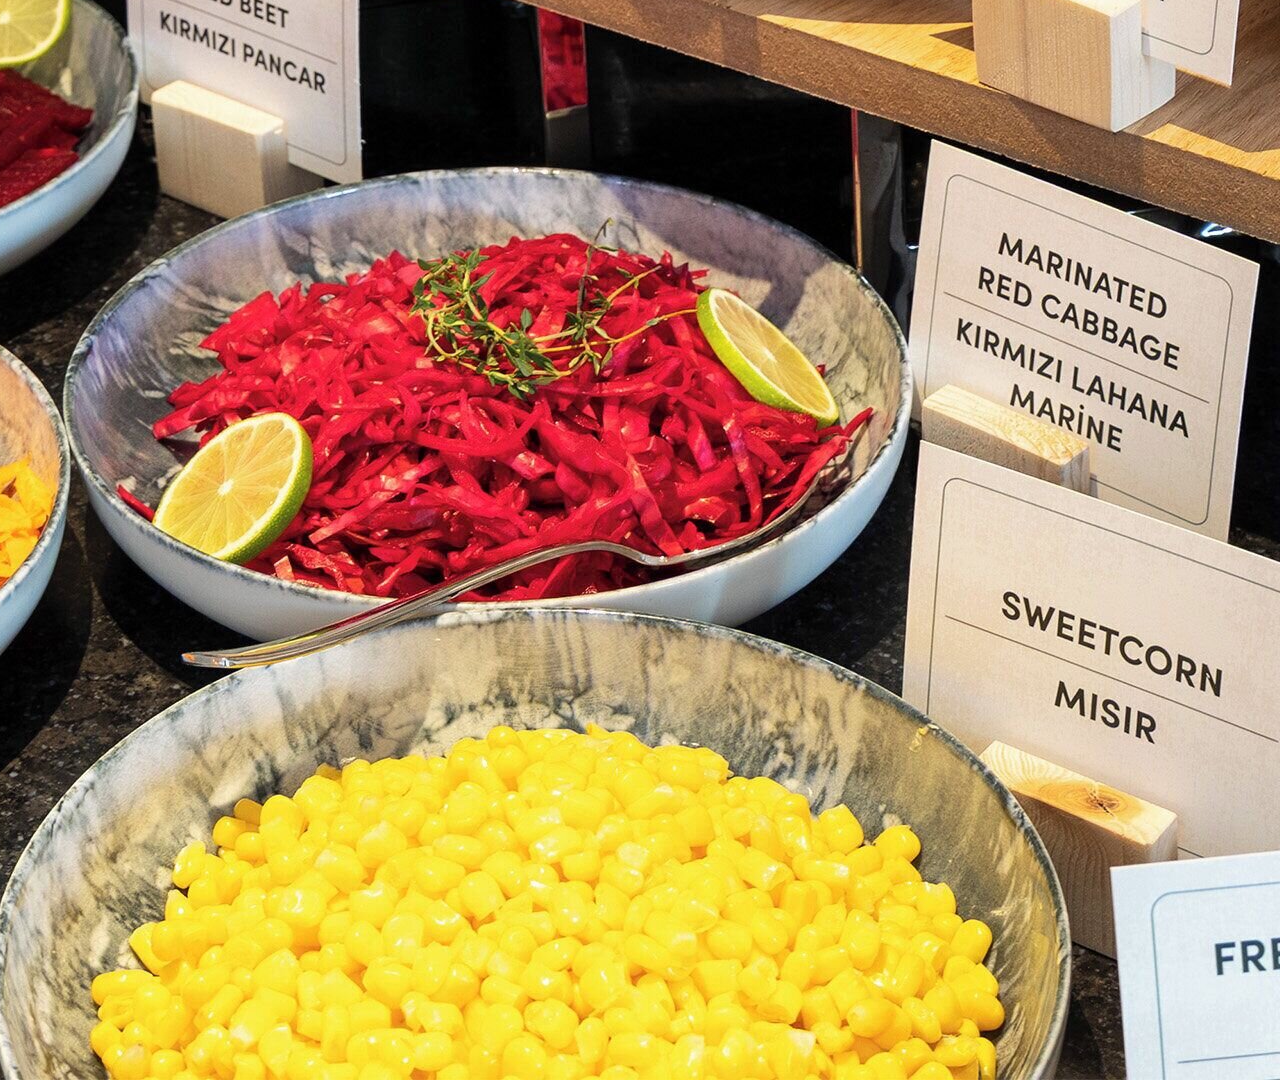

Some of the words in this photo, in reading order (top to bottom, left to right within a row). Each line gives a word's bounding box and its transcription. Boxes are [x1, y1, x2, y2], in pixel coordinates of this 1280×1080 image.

[159, 10, 236, 58] KIRMIZI
[242, 43, 327, 94] PANCAR
[978, 266, 1033, 308] RED
[1041, 294, 1180, 371] CABBAGE
[998, 232, 1168, 319] MARINATED
[956, 317, 1063, 384] KIRMIZI
[1071, 366, 1189, 439] LAHANA
[1009, 383, 1123, 453] MARİNE
[1001, 590, 1223, 698] SWEETCORN
[1054, 680, 1158, 744] MISIR
